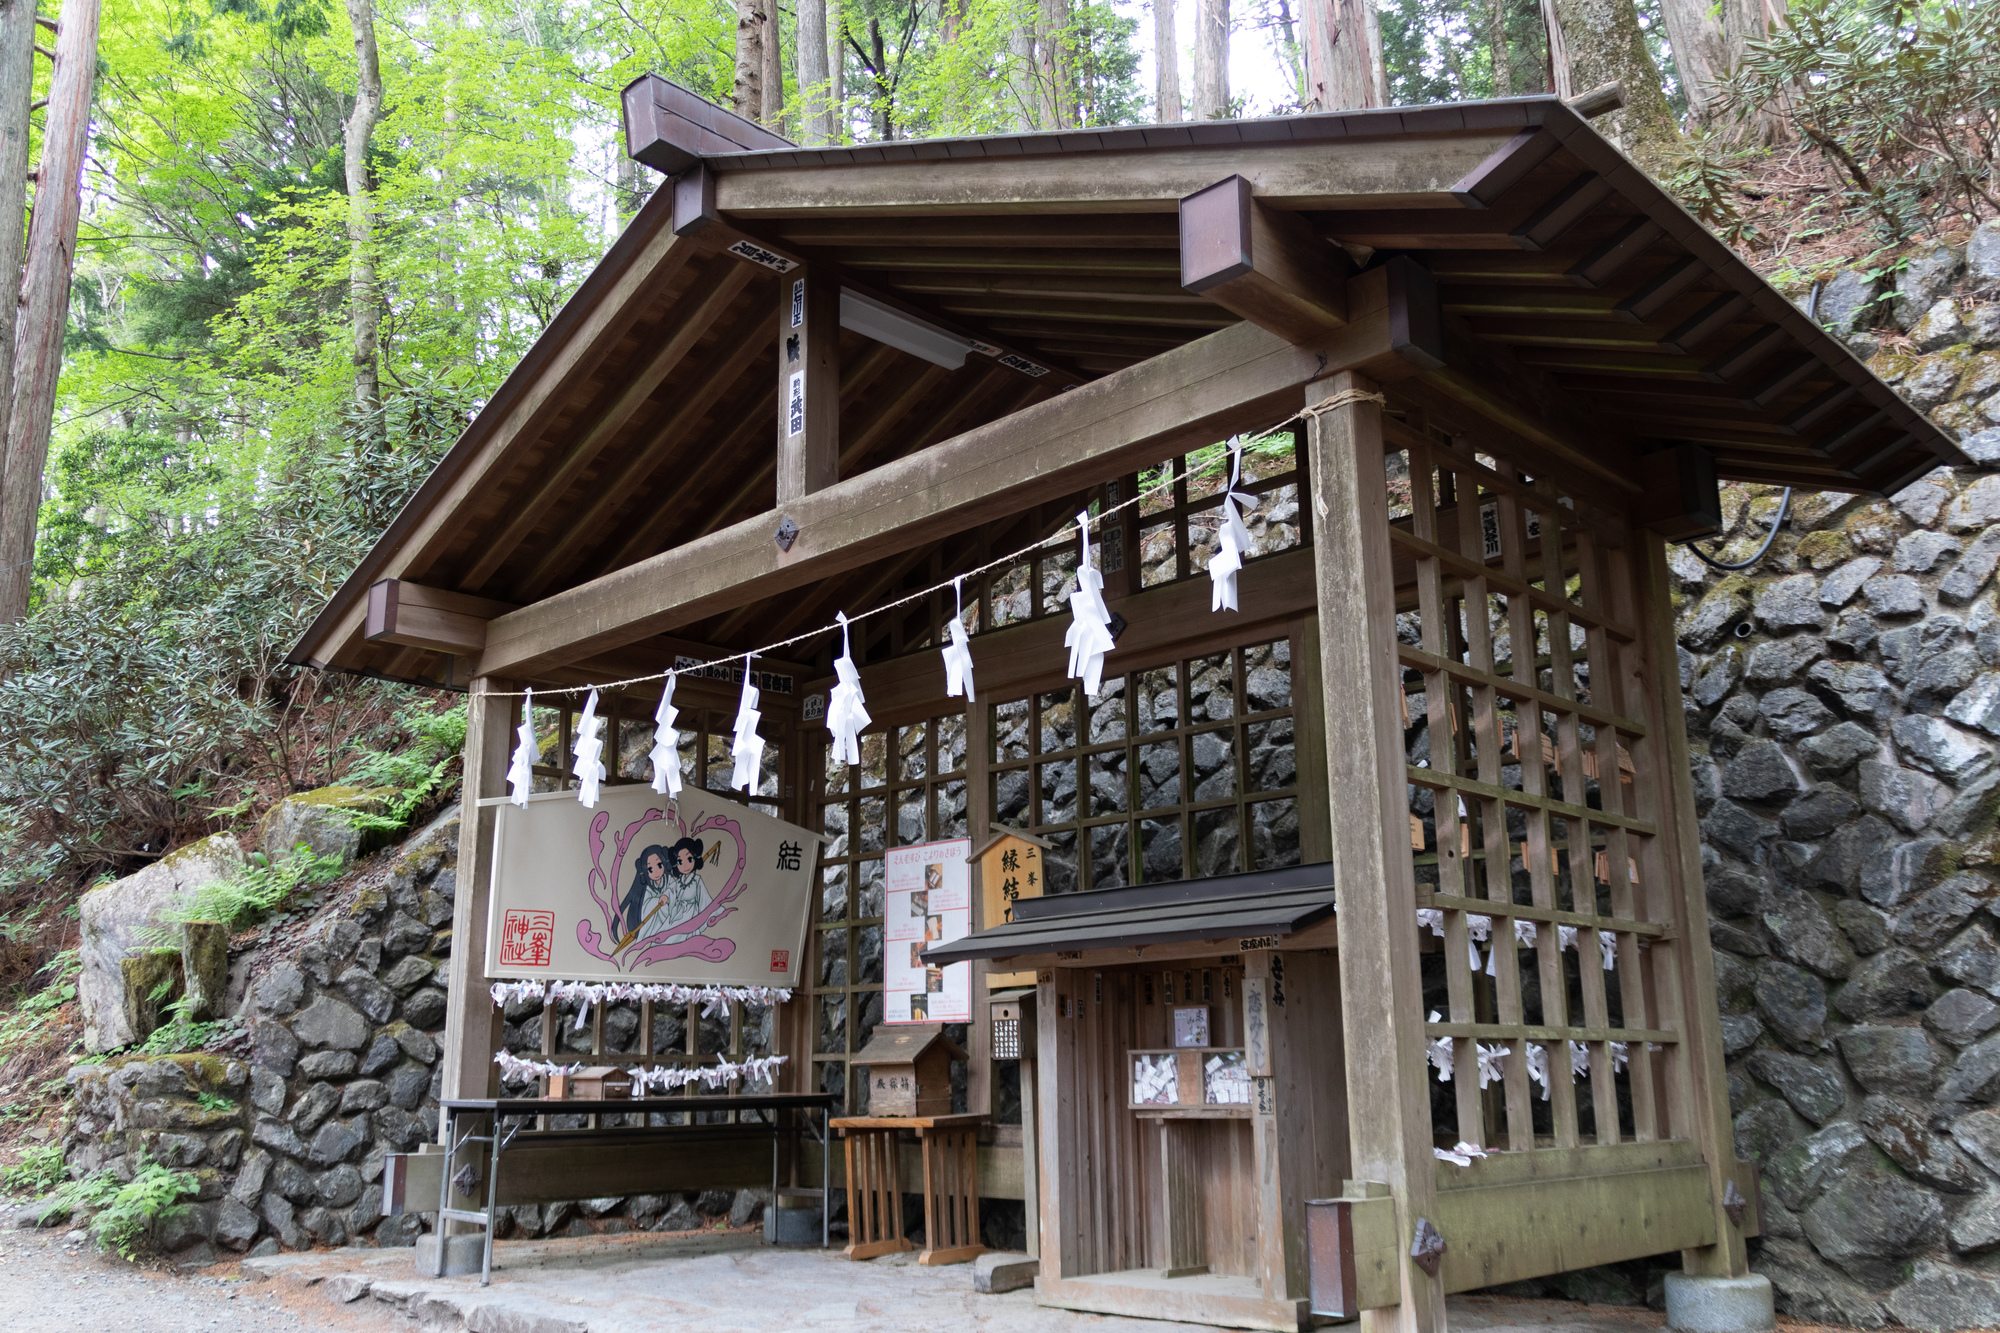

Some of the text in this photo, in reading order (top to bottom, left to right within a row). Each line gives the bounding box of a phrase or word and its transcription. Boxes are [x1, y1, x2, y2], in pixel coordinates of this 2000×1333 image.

[790, 395, 803, 436] 武田
[776, 840, 803, 871] 結
[1025, 847, 1039, 888] 三峯
[1247, 989, 1265, 1069] 恋みくじ
